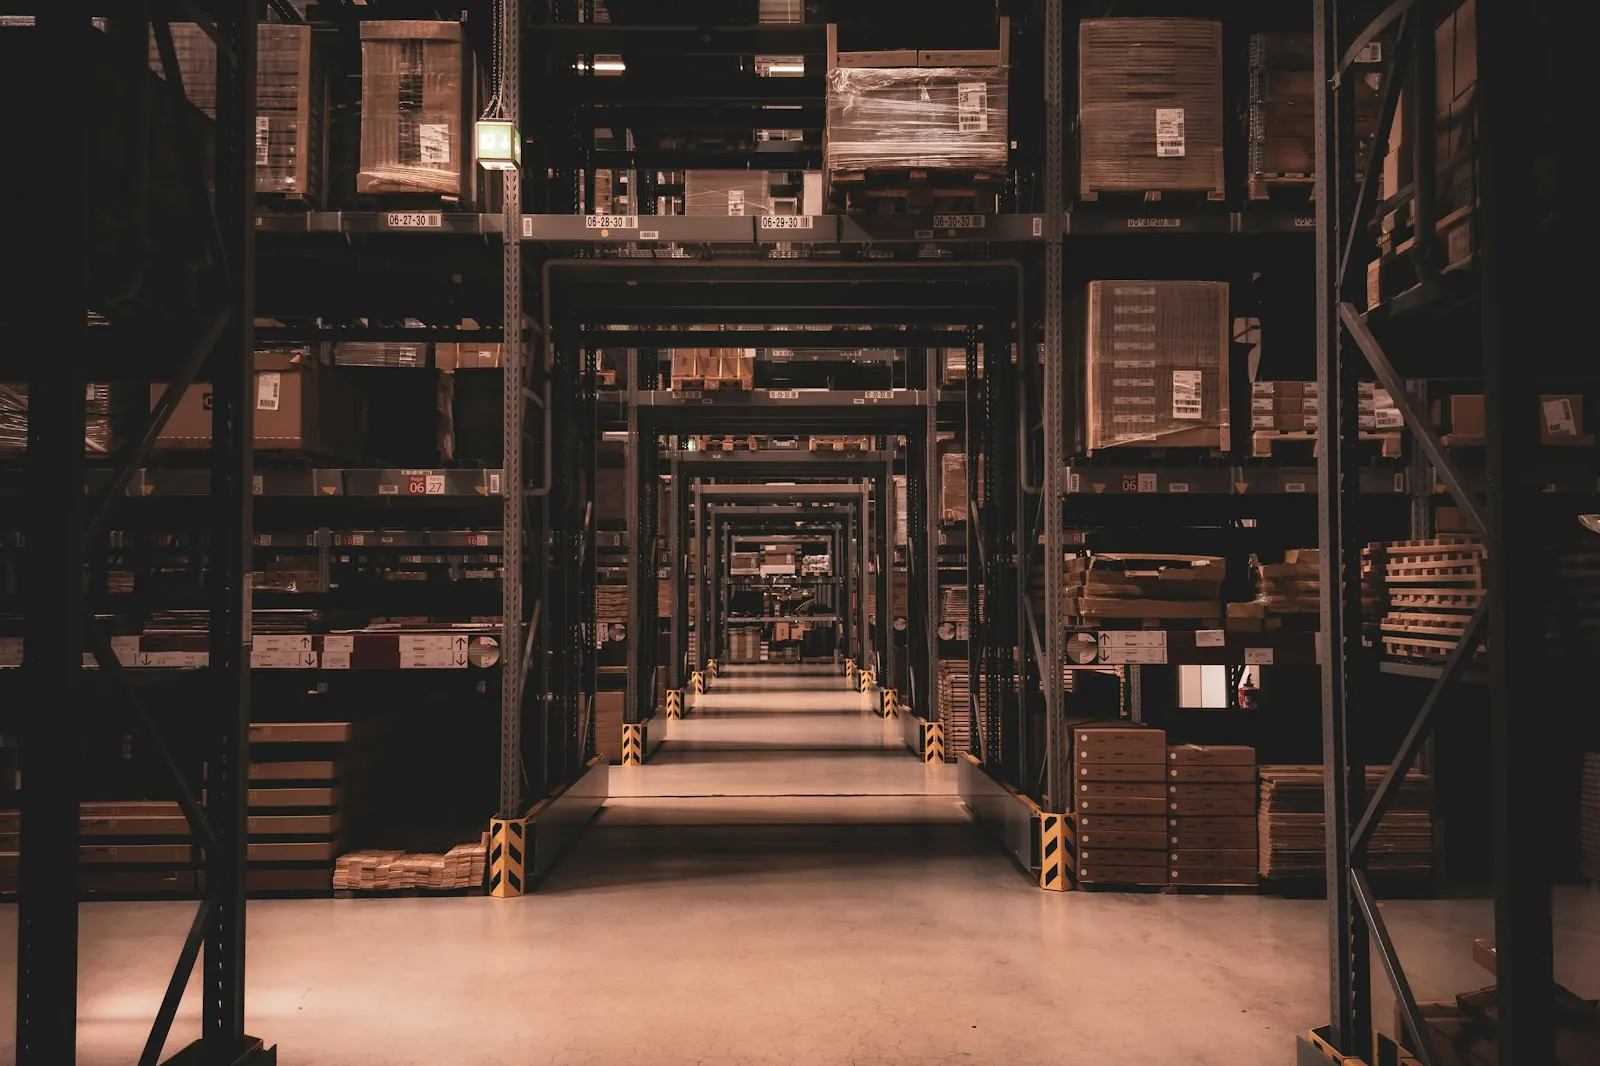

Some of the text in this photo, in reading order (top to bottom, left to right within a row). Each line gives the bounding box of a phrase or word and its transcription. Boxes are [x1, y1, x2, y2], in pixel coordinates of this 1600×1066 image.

[389, 215, 425, 226] 06-27-30
[587, 216, 622, 227] 06-28-30
[763, 217, 797, 228] 06-29-30
[935, 216, 970, 227] 06-30-30
[410, 482, 442, 493] 06 27
[1122, 480, 1154, 491] 06 31
